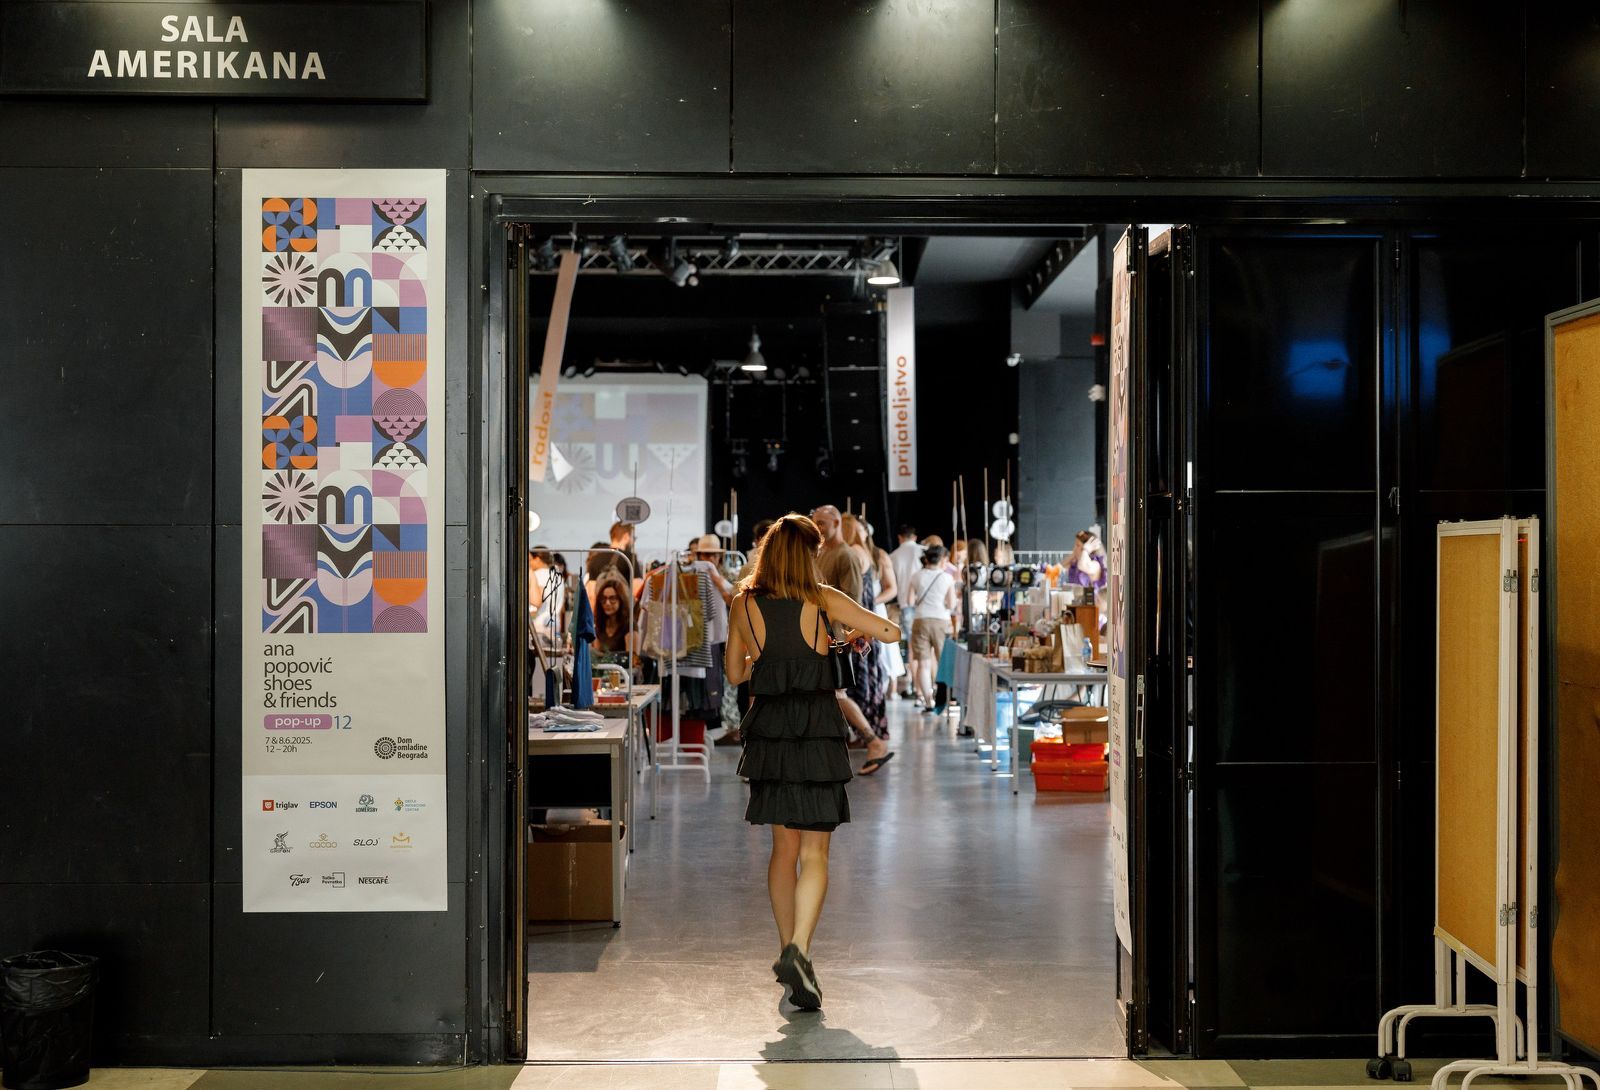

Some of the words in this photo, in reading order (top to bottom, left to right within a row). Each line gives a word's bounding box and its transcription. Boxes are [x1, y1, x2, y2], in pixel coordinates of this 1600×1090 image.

[161, 15, 249, 43] SALA
[87, 49, 326, 80] AMERIKANA
[892, 356, 912, 477] prijateljstvo
[531, 391, 553, 465] radost
[263, 644, 295, 656] ana
[264, 657, 333, 677] popović
[264, 675, 312, 691] shoes
[264, 692, 277, 708] &
[280, 692, 337, 708] friends
[275, 717, 321, 728] pop-up
[334, 716, 352, 730] 12
[278, 736, 312, 745] 8.6.2025.
[397, 752, 429, 760] Beograda
[276, 802, 298, 810] triglav
[309, 801, 338, 809] EPSON
[353, 838, 378, 846] SLOJ
[358, 875, 389, 884] NESCAFÉ
